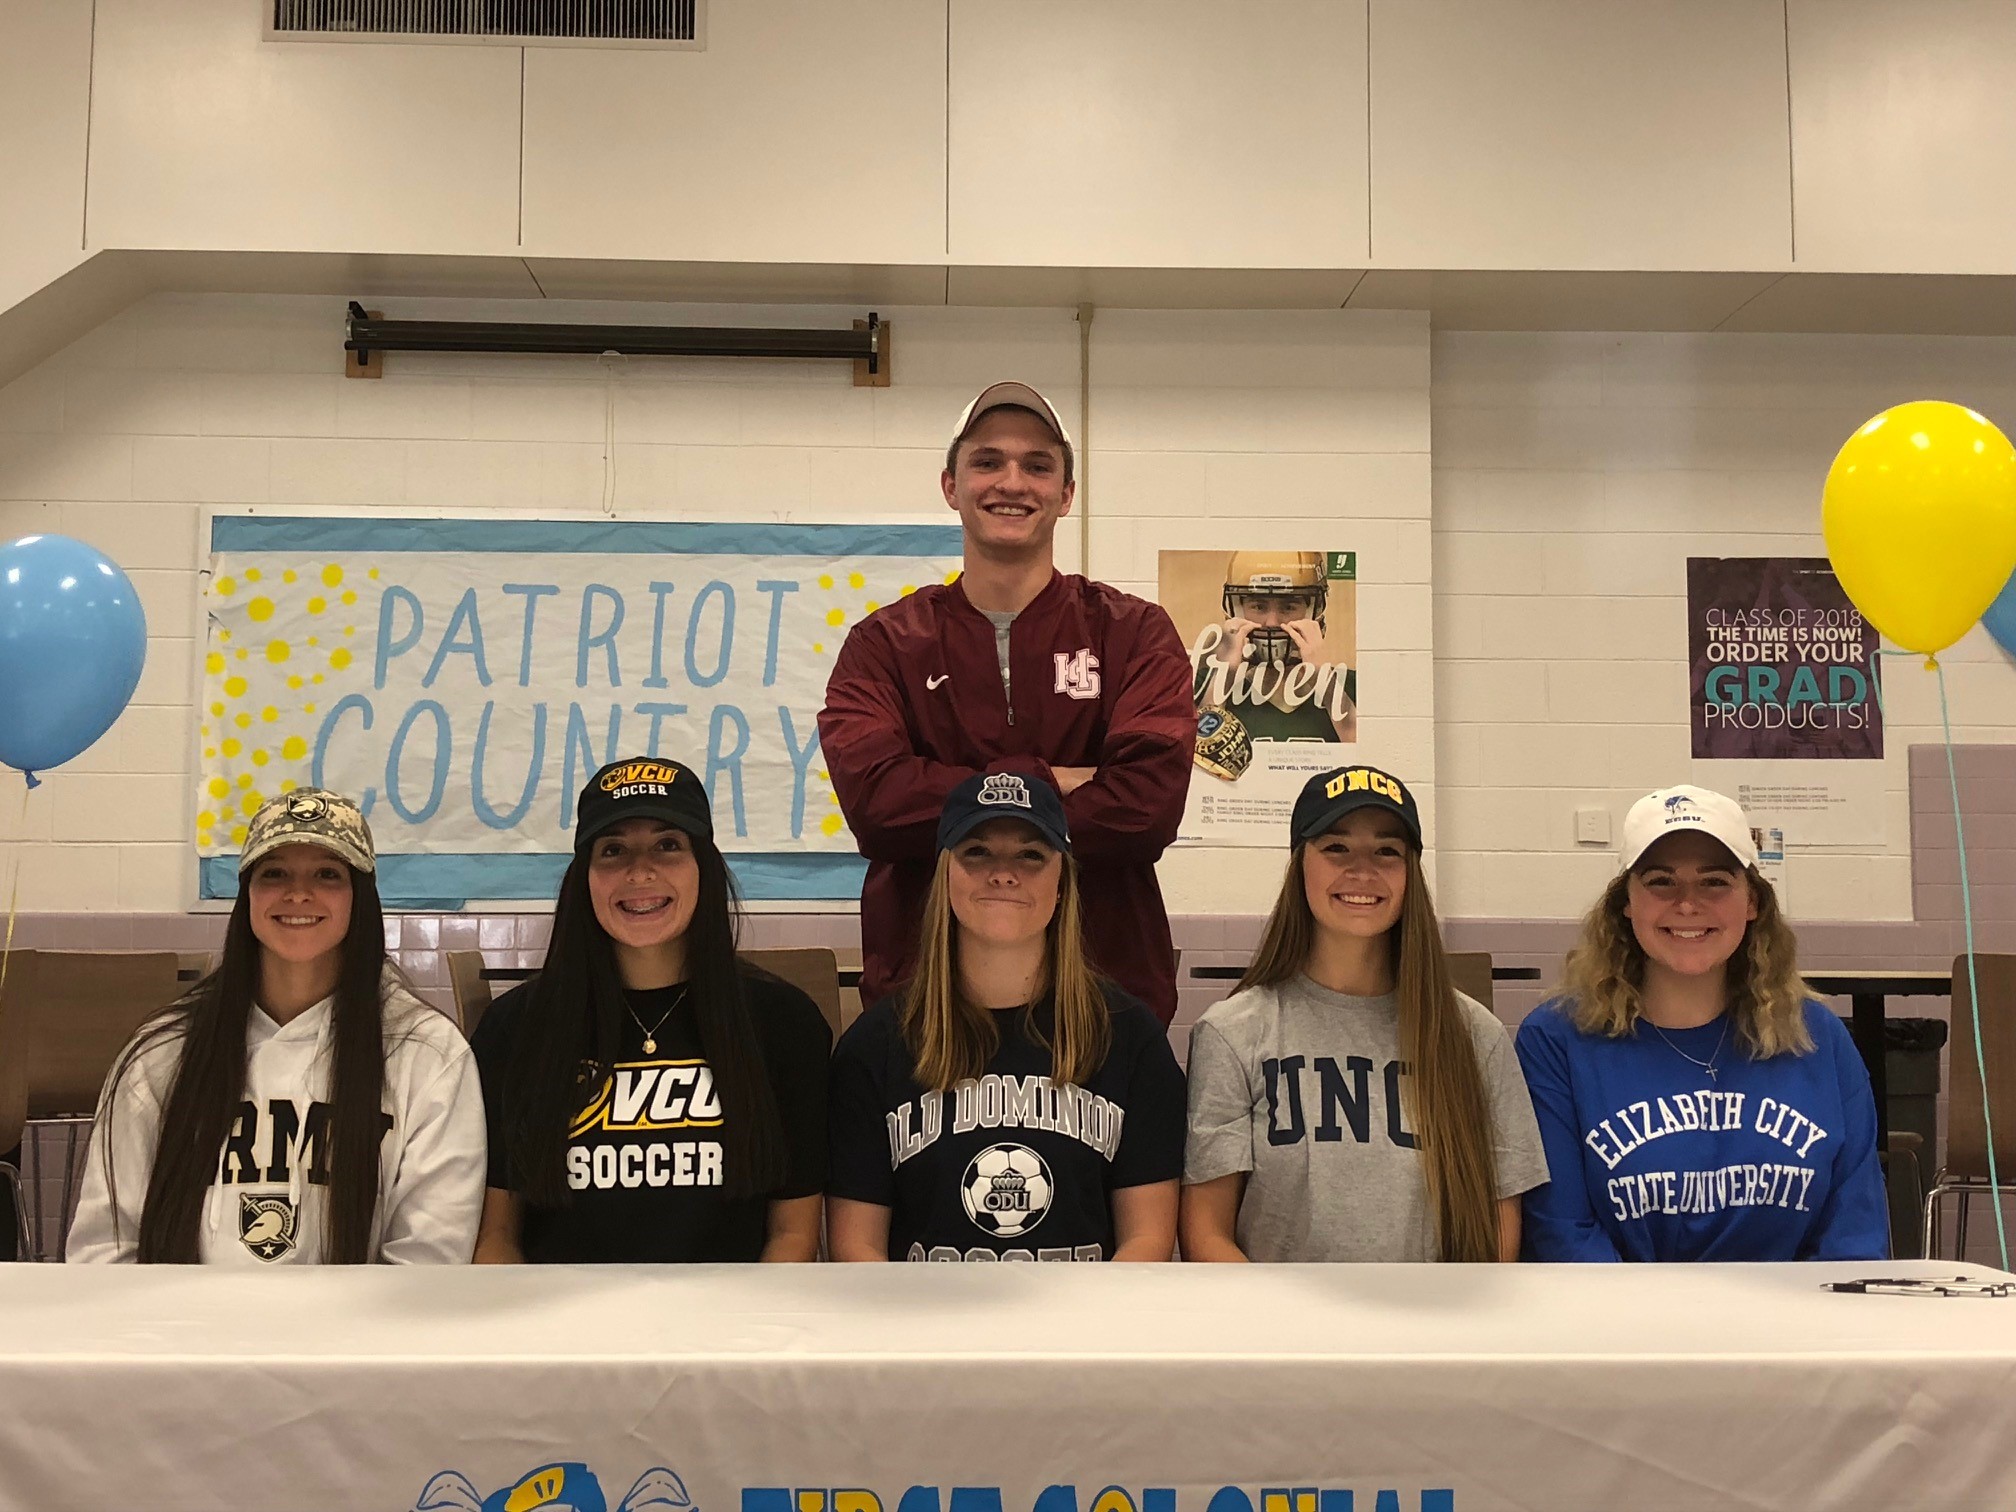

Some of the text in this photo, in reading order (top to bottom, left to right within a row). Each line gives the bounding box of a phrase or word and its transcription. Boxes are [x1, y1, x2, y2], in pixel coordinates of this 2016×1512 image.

[1706, 609, 1862, 628] CLASS OF 2018
[375, 581, 799, 690] PATRIOT
[1707, 627, 1862, 642] THE TIME IS NOW!
[1707, 643, 1864, 663] ORDER YOUR
[1704, 666, 1868, 709] GRAD
[1704, 702, 1869, 729] PRODUCTS!
[626, 765, 675, 782] VCU
[613, 784, 668, 799] SOCCER
[980, 788, 1031, 807] ODU
[613, 1067, 722, 1121] VCU
[1585, 1090, 1827, 1170] ELIZABETH CITY
[566, 1142, 723, 1190] SOCCER
[984, 1190, 1031, 1212] ODU
[1607, 1163, 1815, 1222] STATE UNIVERSITY
